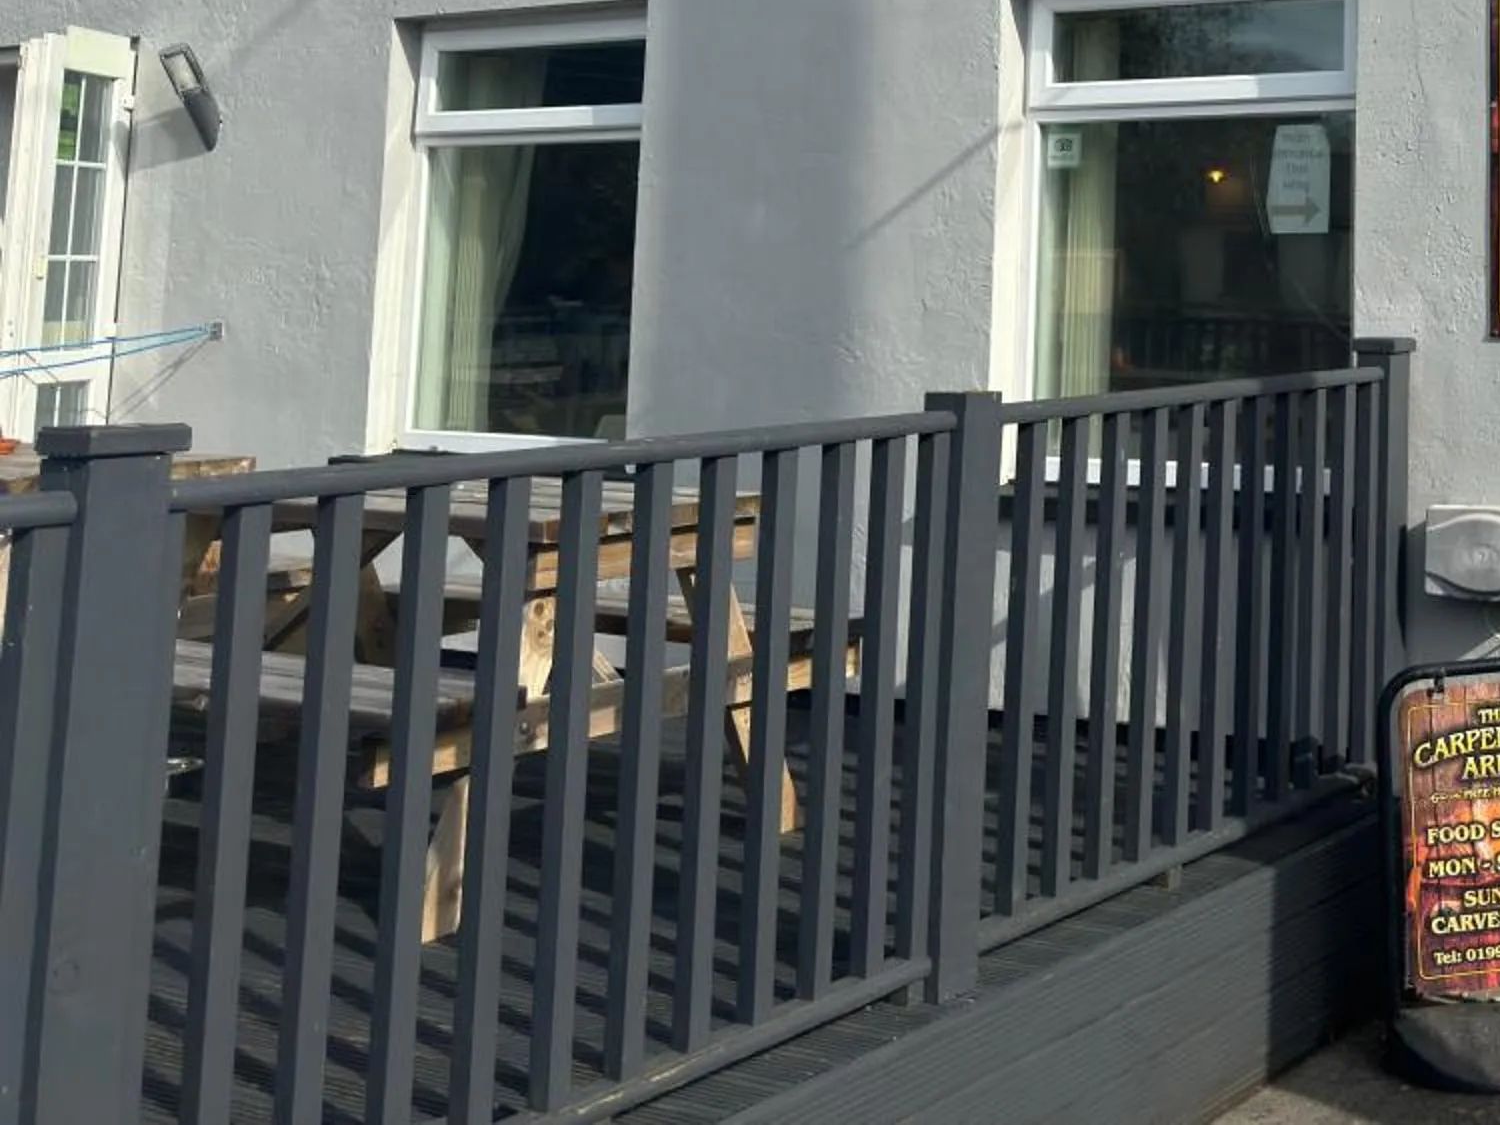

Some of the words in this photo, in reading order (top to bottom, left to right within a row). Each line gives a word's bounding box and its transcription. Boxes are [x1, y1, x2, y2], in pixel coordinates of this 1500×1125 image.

[1427, 823, 1486, 845] FOOD
[1428, 856, 1476, 878] MON
[1434, 950, 1463, 965] Tel:
